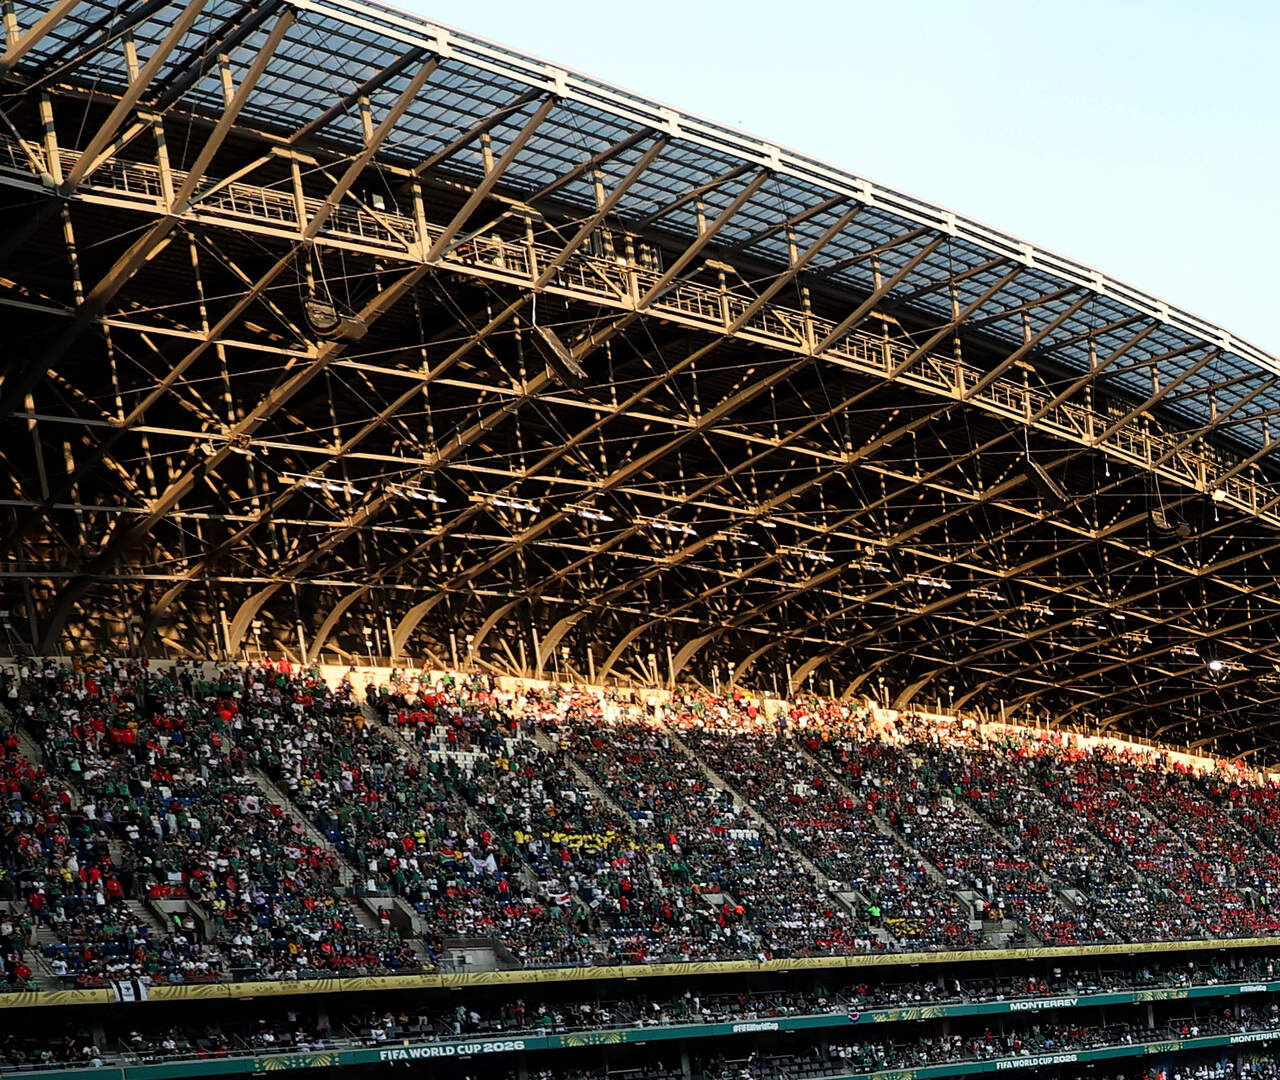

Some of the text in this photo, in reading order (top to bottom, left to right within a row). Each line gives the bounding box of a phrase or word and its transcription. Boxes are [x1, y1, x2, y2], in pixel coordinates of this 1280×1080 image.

[1010, 998, 1079, 1011] MONTERREY
[733, 1022, 778, 1033] #FIFAWorldCup
[380, 1040, 525, 1062] FIFA WORLD CUP 2026
[996, 1053, 1078, 1069] FIFA WORLD CUP 2026
